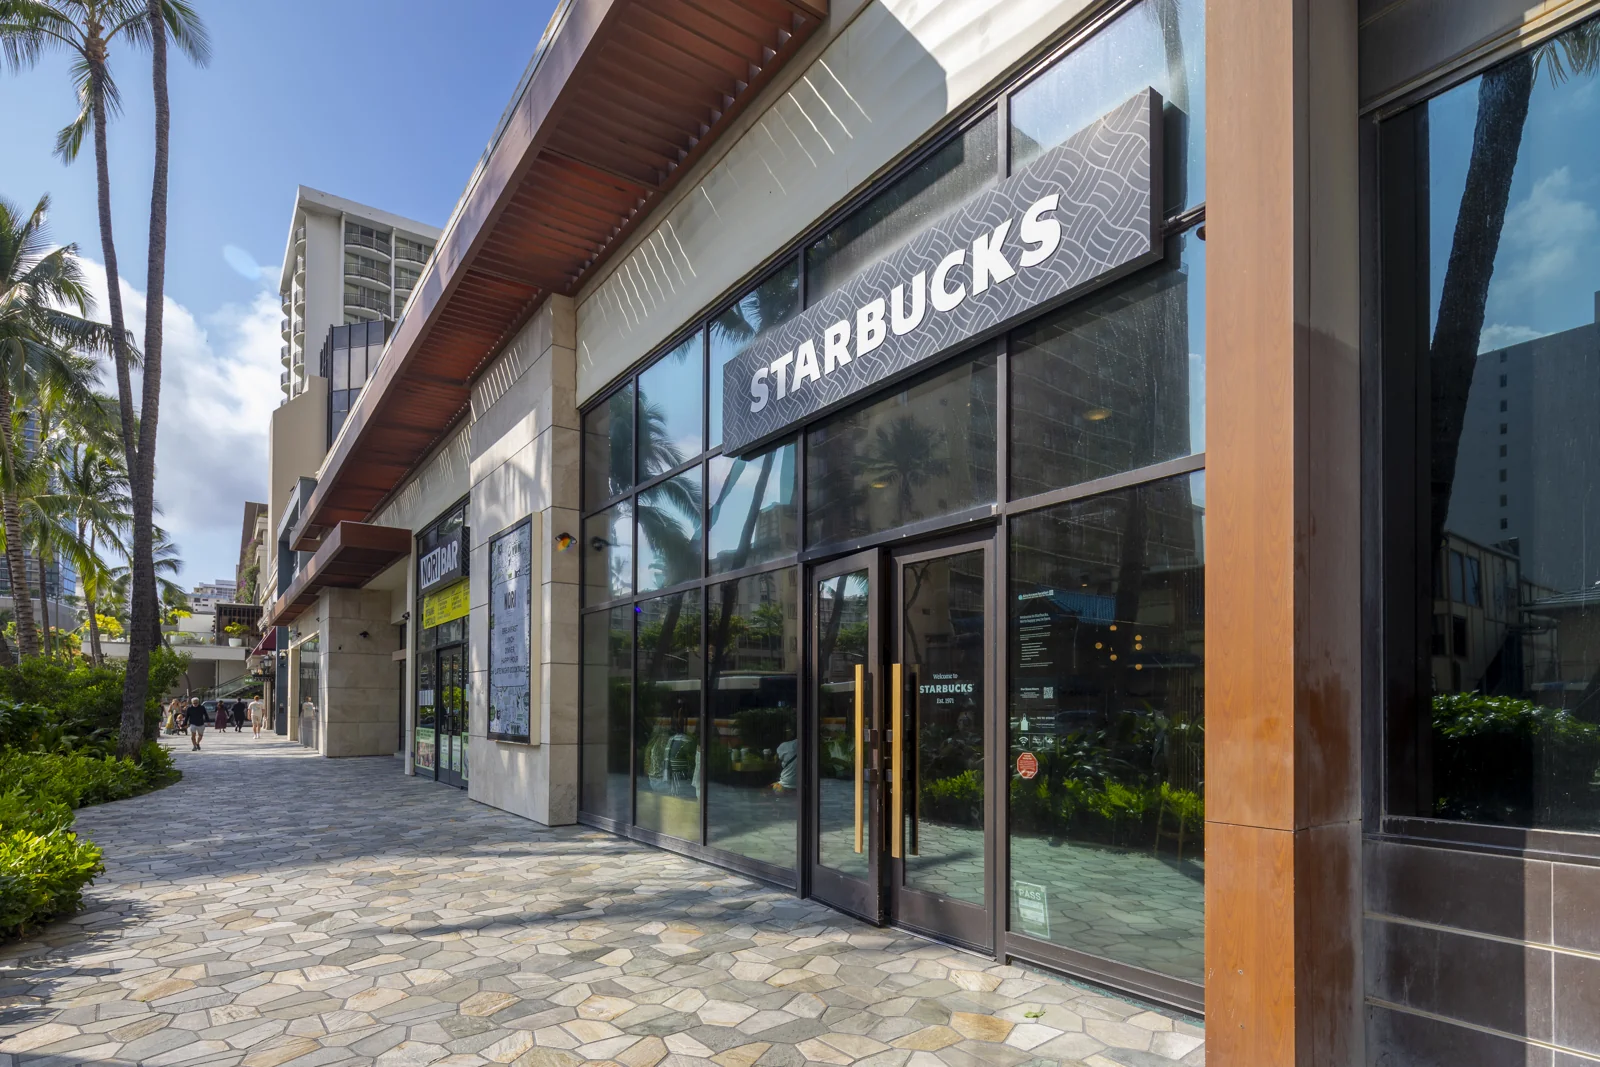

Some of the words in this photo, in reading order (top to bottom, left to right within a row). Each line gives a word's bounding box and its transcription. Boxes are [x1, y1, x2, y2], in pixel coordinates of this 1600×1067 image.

[749, 193, 1062, 414] STARBUCKS
[422, 550, 439, 587] NORI
[440, 540, 458, 576] BAR
[504, 589, 517, 610] NORI
[919, 683, 974, 694] STARBUCKS
[1018, 888, 1042, 901] PASS
